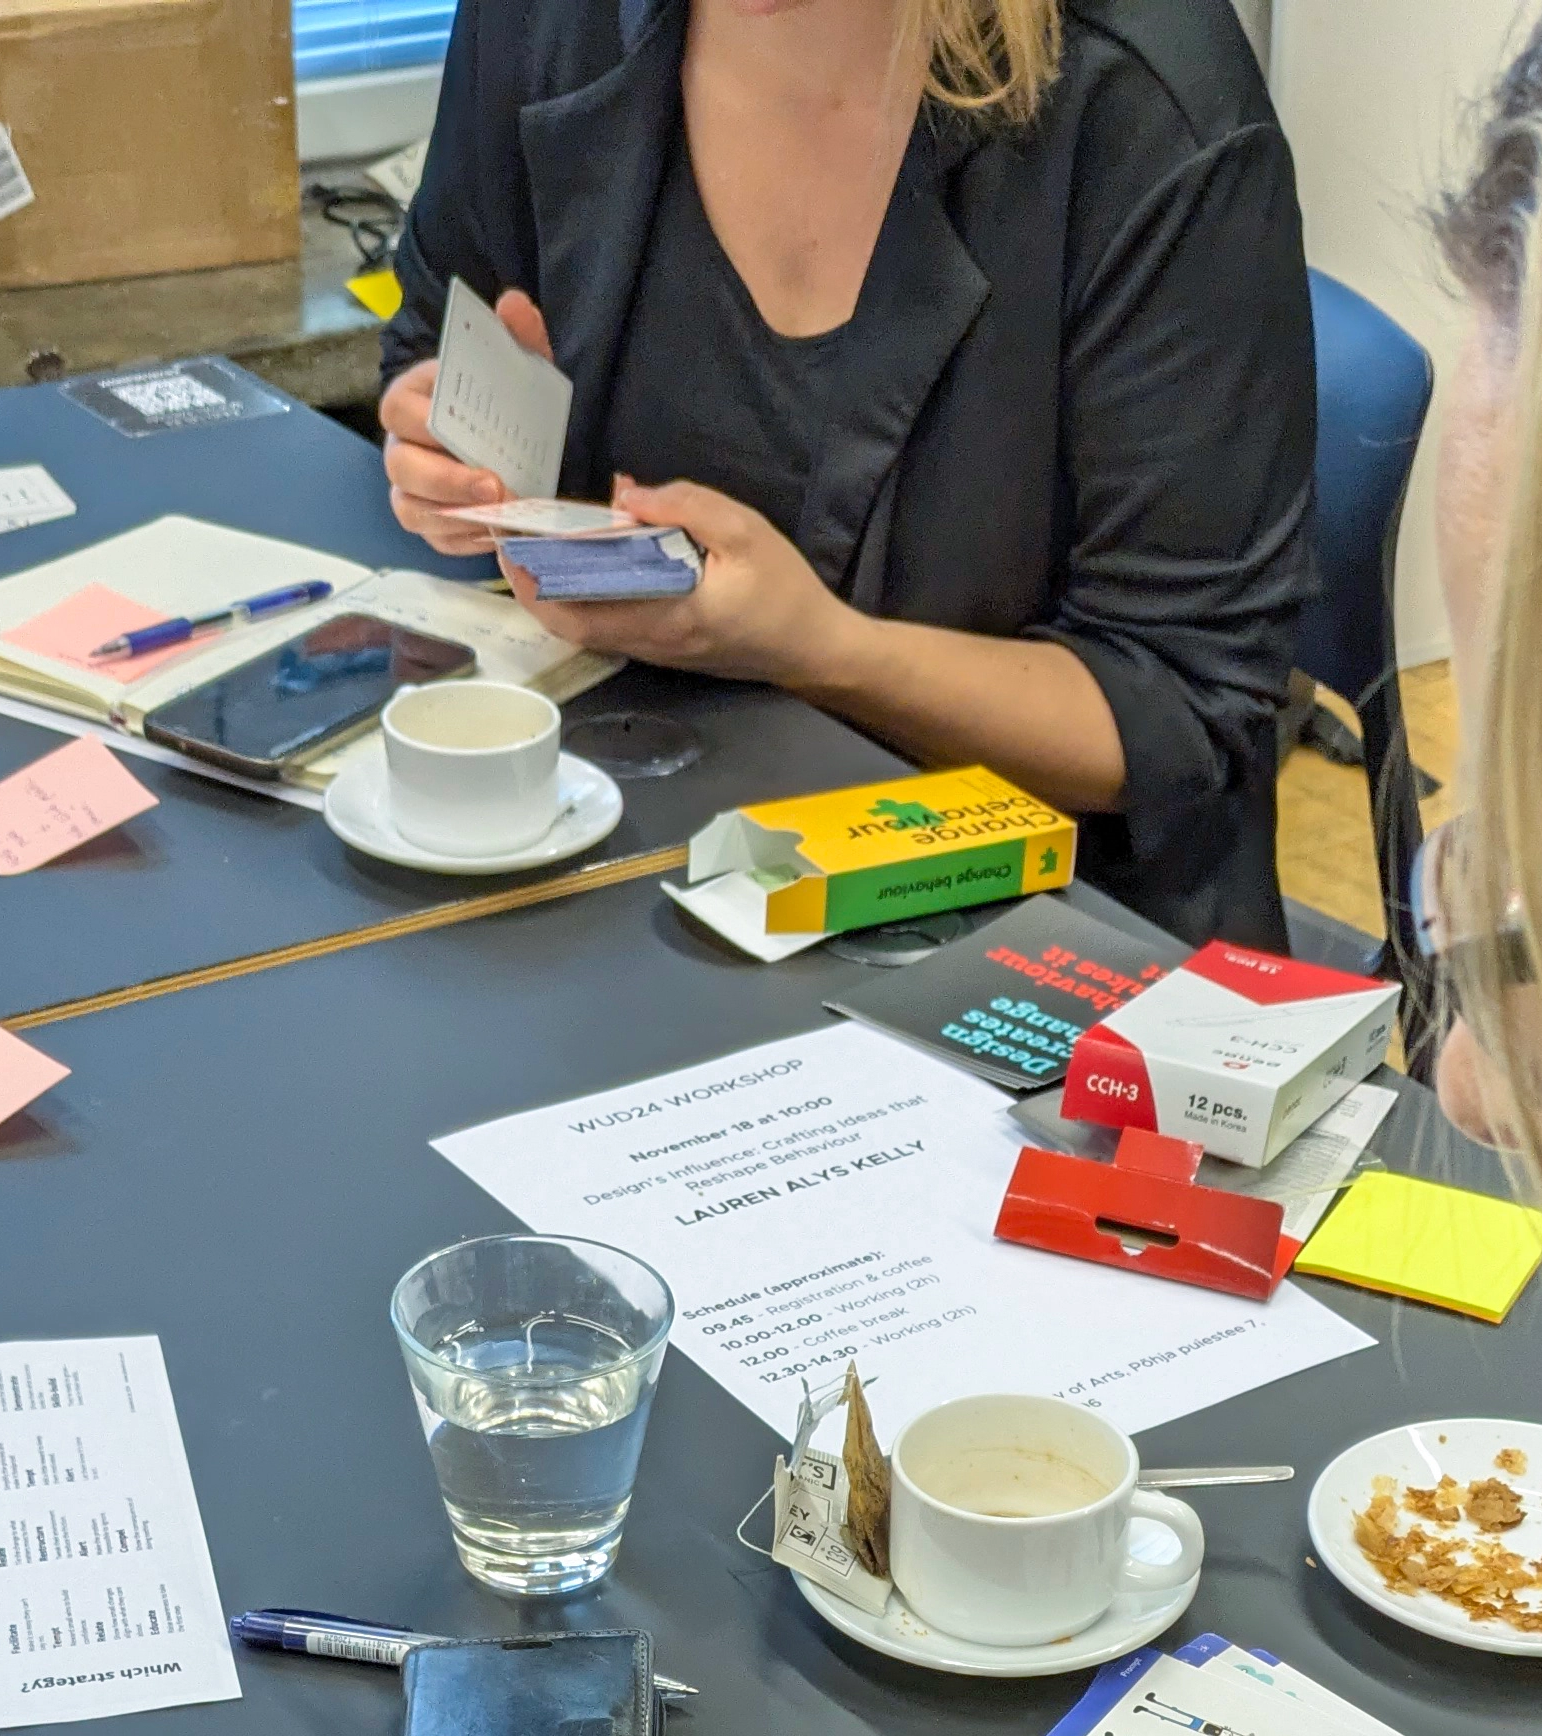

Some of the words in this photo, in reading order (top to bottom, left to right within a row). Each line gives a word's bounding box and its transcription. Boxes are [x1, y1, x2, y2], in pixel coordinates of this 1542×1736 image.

[847, 795, 1044, 840] behaviour
[911, 810, 1059, 846] Change
[877, 872, 952, 903] behaviour
[955, 860, 1012, 888] Change
[940, 1022, 1058, 1075] Design
[567, 1101, 663, 1133] WUD24
[663, 1058, 803, 1107] WORKSHOP
[1085, 1073, 1140, 1101] CCH-3
[1182, 1109, 1208, 1124] Made
[1209, 1116, 1220, 1127] in
[1219, 1119, 1248, 1135] Korea
[1186, 1093, 1209, 1111] 12
[1211, 1100, 1249, 1123] pcs.
[628, 1128, 728, 1162] November
[730, 1120, 754, 1132] 18
[757, 1113, 778, 1125] at
[777, 1096, 833, 1117] 10:00
[582, 1175, 667, 1205] Design's
[666, 1147, 761, 1179] Influence:
[761, 1123, 838, 1150] Crafting
[836, 1108, 888, 1128] Ideas
[887, 1094, 928, 1112] that
[684, 1161, 769, 1193] Reshape
[768, 1132, 862, 1165] Behaviour
[674, 1186, 781, 1226] LAUREN
[785, 1165, 850, 1192] ALYS
[849, 1139, 924, 1170] KELLY
[681, 1292, 762, 1320] Schedule
[763, 1250, 885, 1295] (approximate):
[701, 1313, 754, 1335] 09.45
[764, 1279, 865, 1315] Registration
[865, 1273, 880, 1282] &
[881, 1256, 933, 1277] coffee
[719, 1313, 823, 1351] 10.00-12.00
[834, 1286, 906, 1313] Working
[905, 1274, 940, 1290] (2h)
[739, 1346, 790, 1367] 12.00
[802, 1324, 859, 1346] Coffee
[858, 1306, 909, 1327] break
[758, 1345, 858, 1383] 12.30-14.30
[869, 1318, 942, 1345] Working
[942, 1305, 977, 1322] (2h)
[1068, 1381, 1087, 1394] of
[1089, 1369, 1131, 1388] Arts,
[1127, 1350, 1178, 1372] Põhja
[1177, 1325, 1246, 1356] puiestee
[115, 1528, 129, 1553] Compel
[8, 1623, 21, 1654] Facilitate
[95, 1620, 106, 1642] Relate
[147, 1609, 160, 1635] Educate
[20, 1667, 117, 1694] strategy?
[119, 1661, 183, 1680] Which
[1120, 1656, 1143, 1678] Prompt
